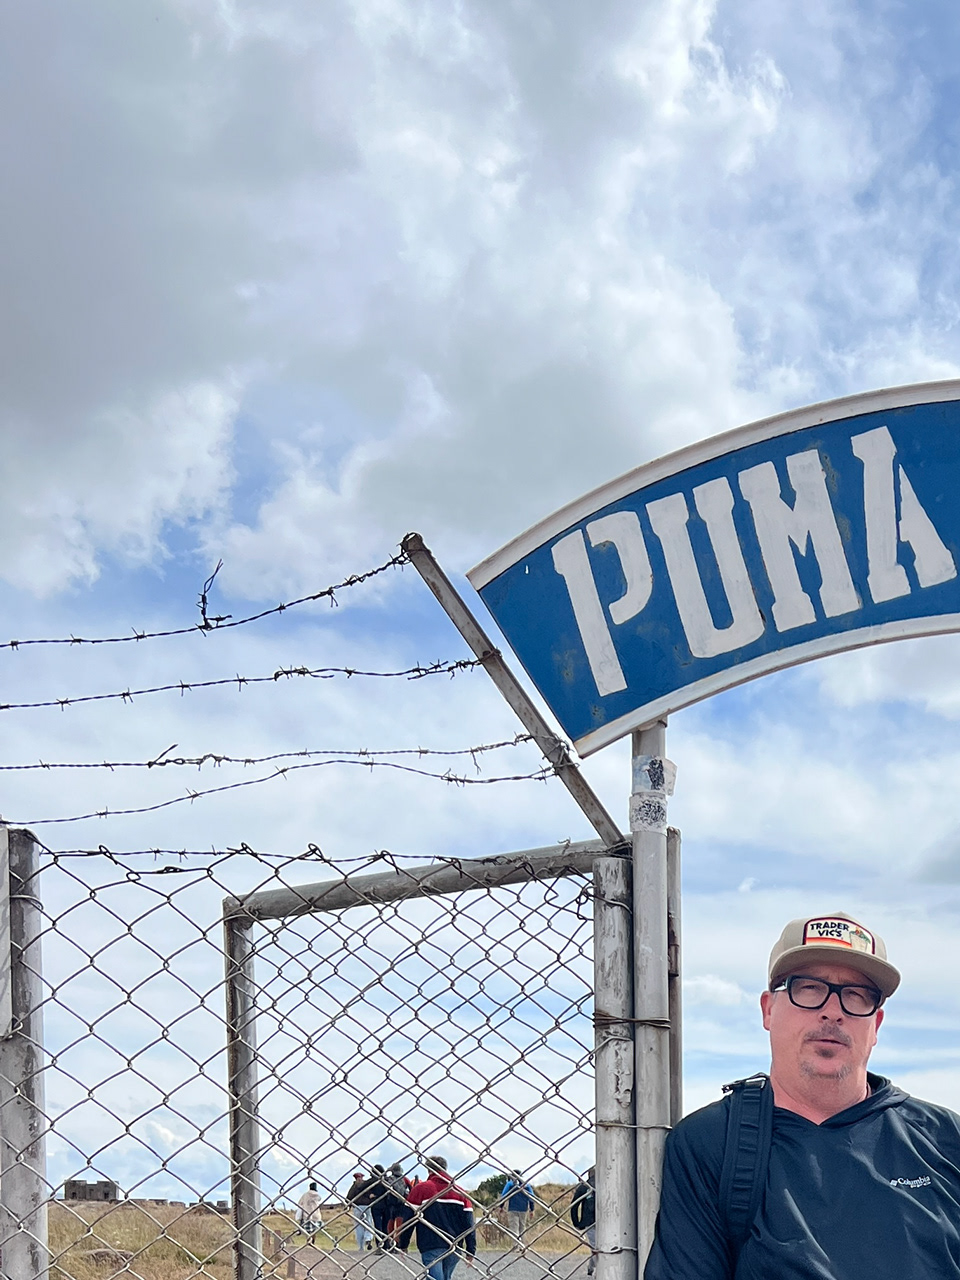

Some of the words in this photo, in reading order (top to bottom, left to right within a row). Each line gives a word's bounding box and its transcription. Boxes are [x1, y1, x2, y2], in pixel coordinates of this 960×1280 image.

[551, 425, 957, 697] PUMA
[810, 921, 849, 931] TRADER
[818, 929, 842, 937] VIC'S
[898, 1176, 931, 1185] Columbia
